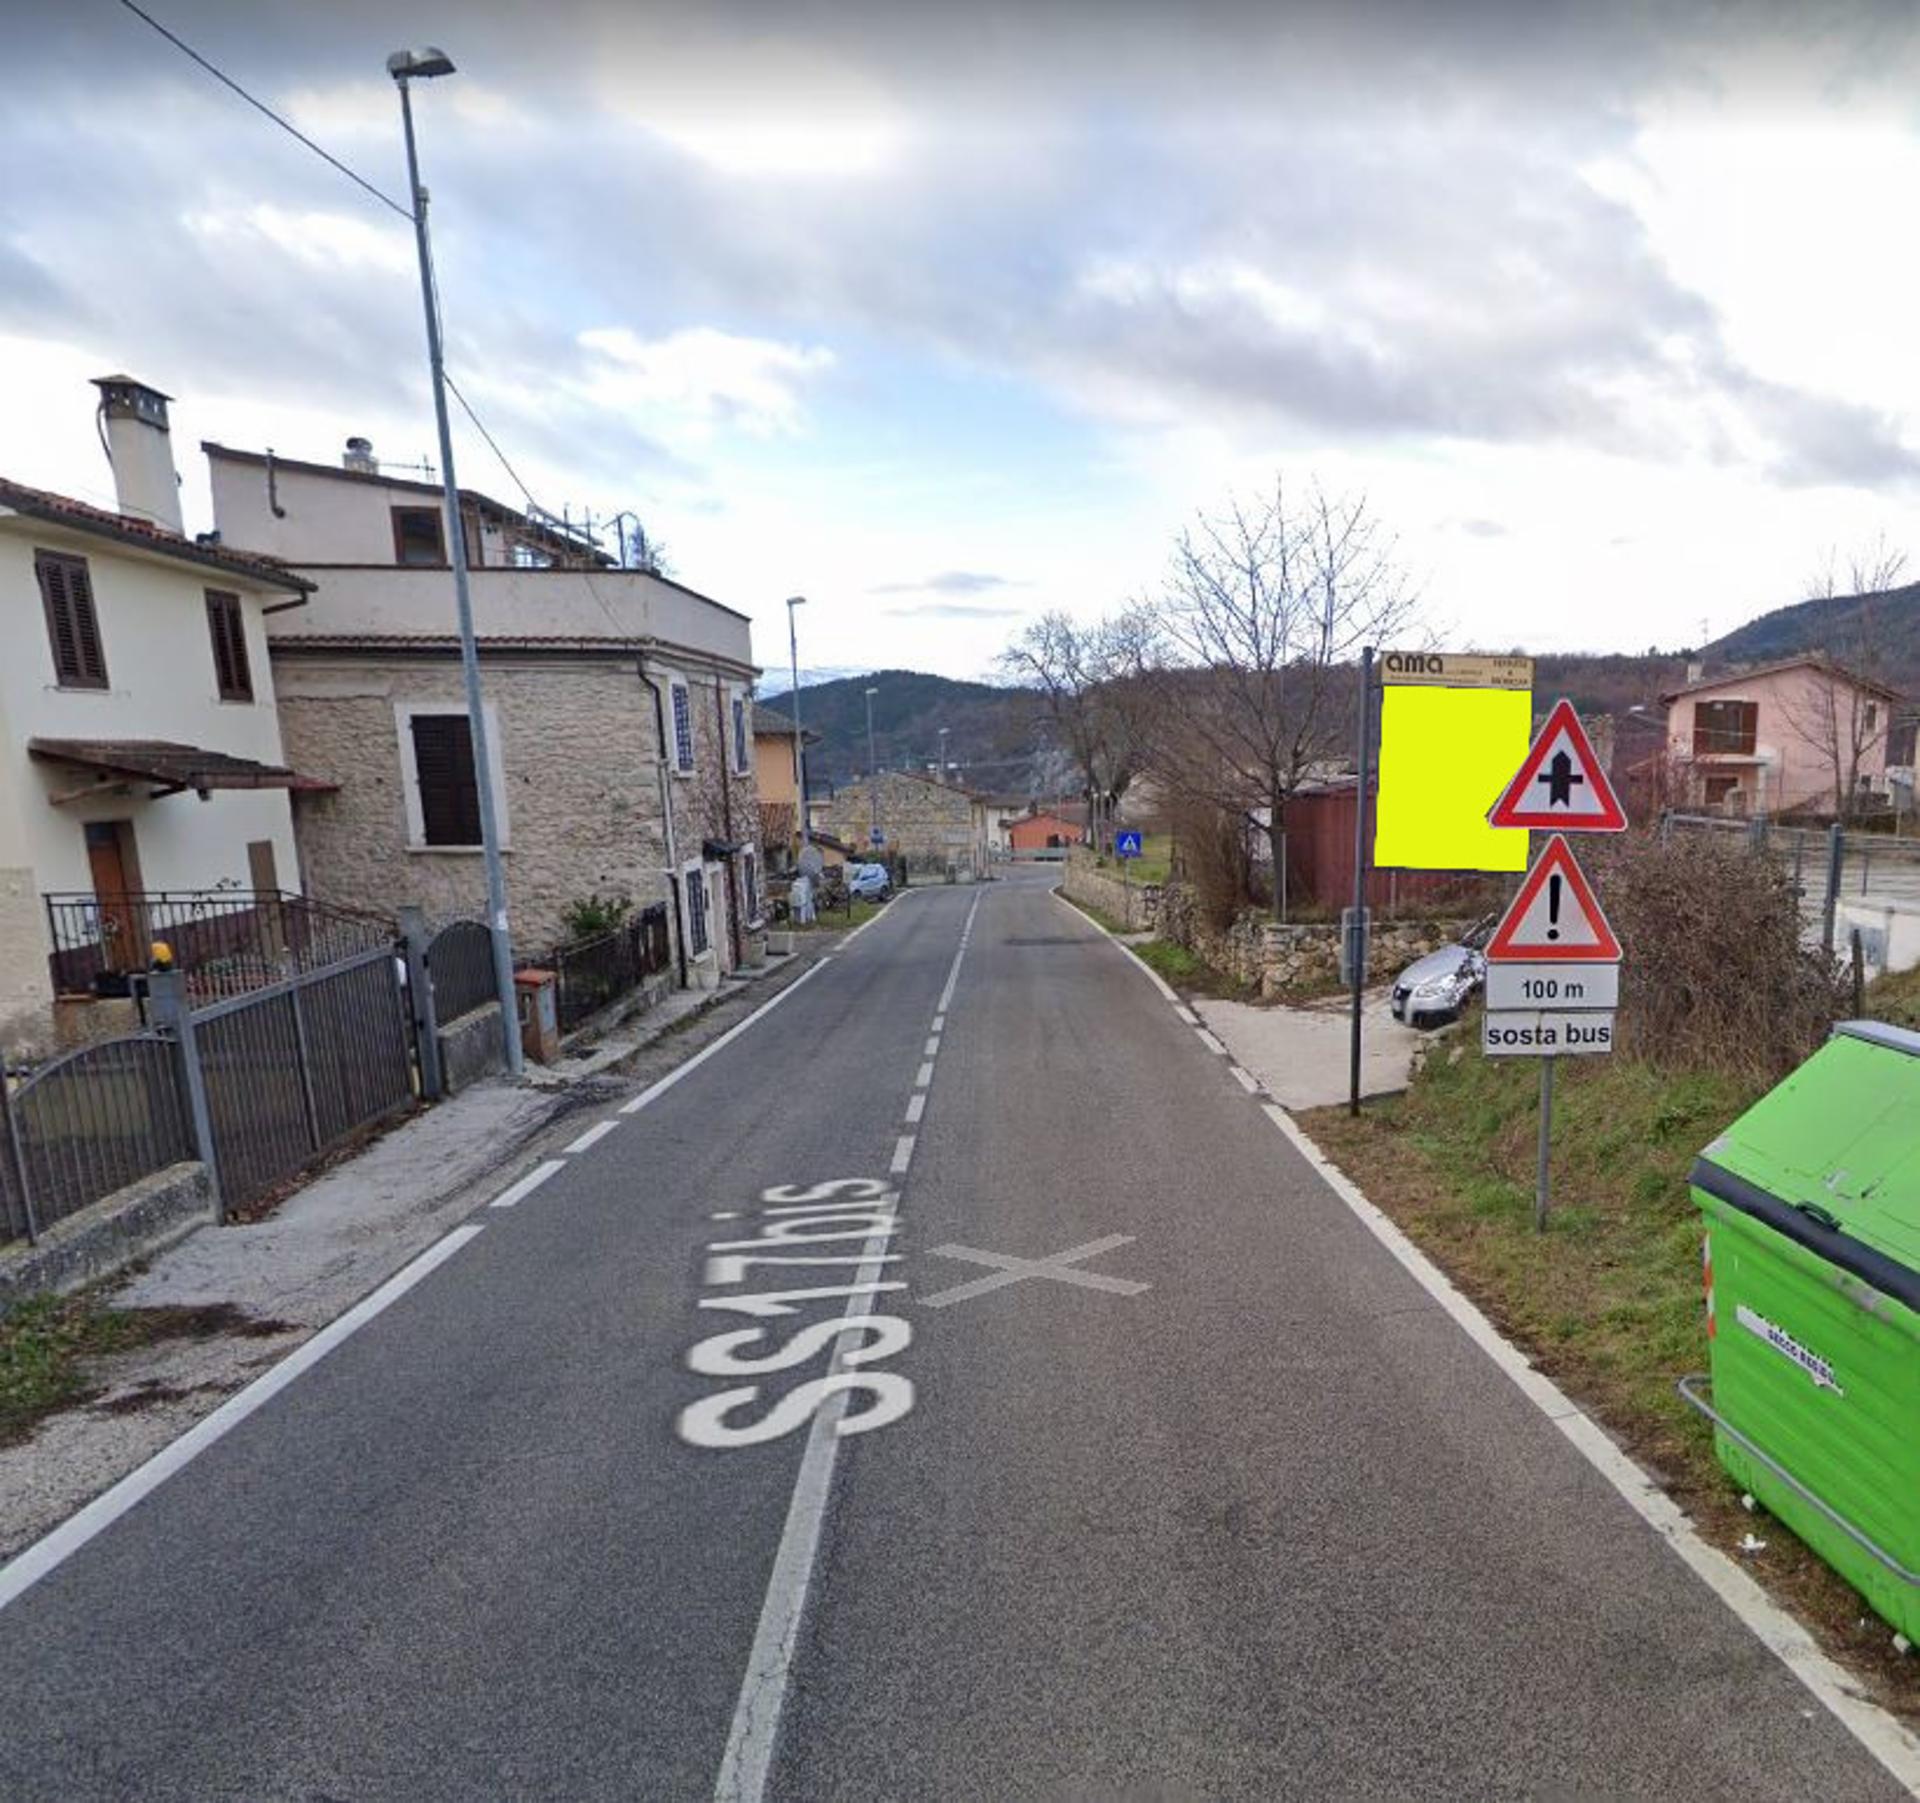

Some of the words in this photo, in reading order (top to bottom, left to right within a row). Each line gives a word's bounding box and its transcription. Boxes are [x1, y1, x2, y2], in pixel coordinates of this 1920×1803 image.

[1387, 654, 1443, 673] ama
[1522, 980, 1557, 998] 100
[1565, 983, 1584, 998] m
[1488, 1026, 1556, 1045] sosta
[1566, 1023, 1610, 1043] bus
